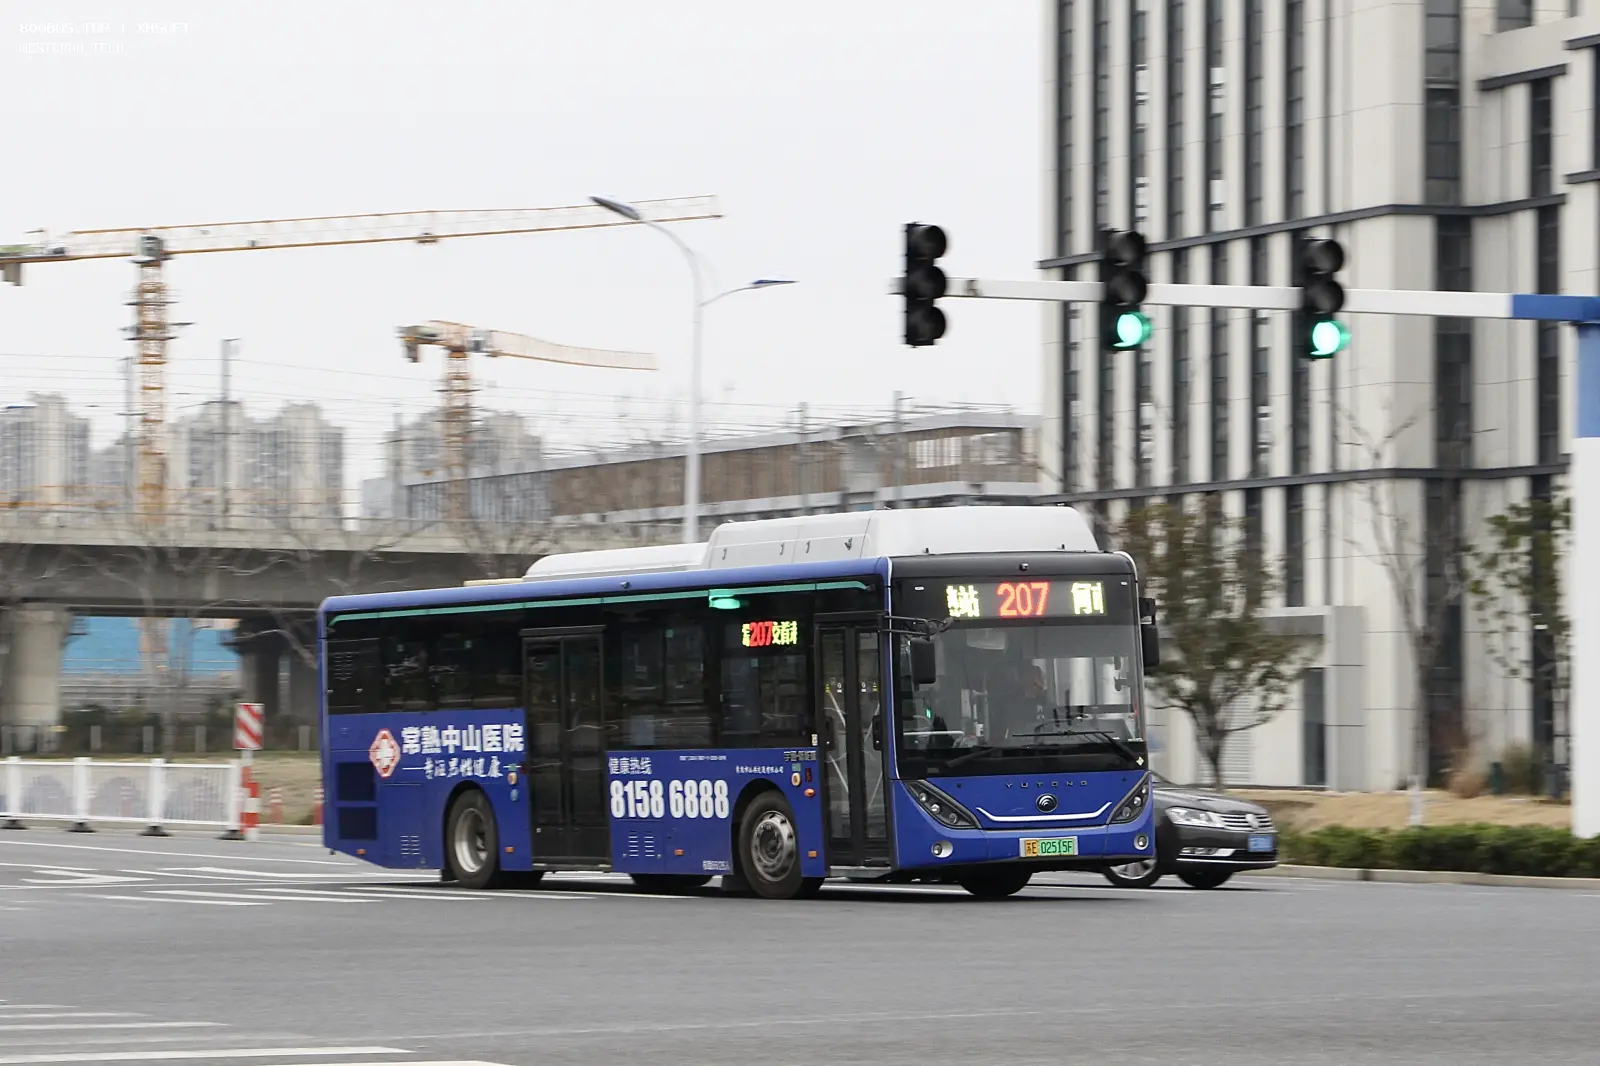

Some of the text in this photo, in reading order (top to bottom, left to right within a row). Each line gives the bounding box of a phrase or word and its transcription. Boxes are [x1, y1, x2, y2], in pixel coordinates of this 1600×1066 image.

[996, 582, 1049, 617] 207
[749, 621, 773, 647] 207
[401, 723, 525, 755] 常熟中山医院
[608, 757, 652, 775] 健康热线
[610, 779, 730, 819] 8158 6888
